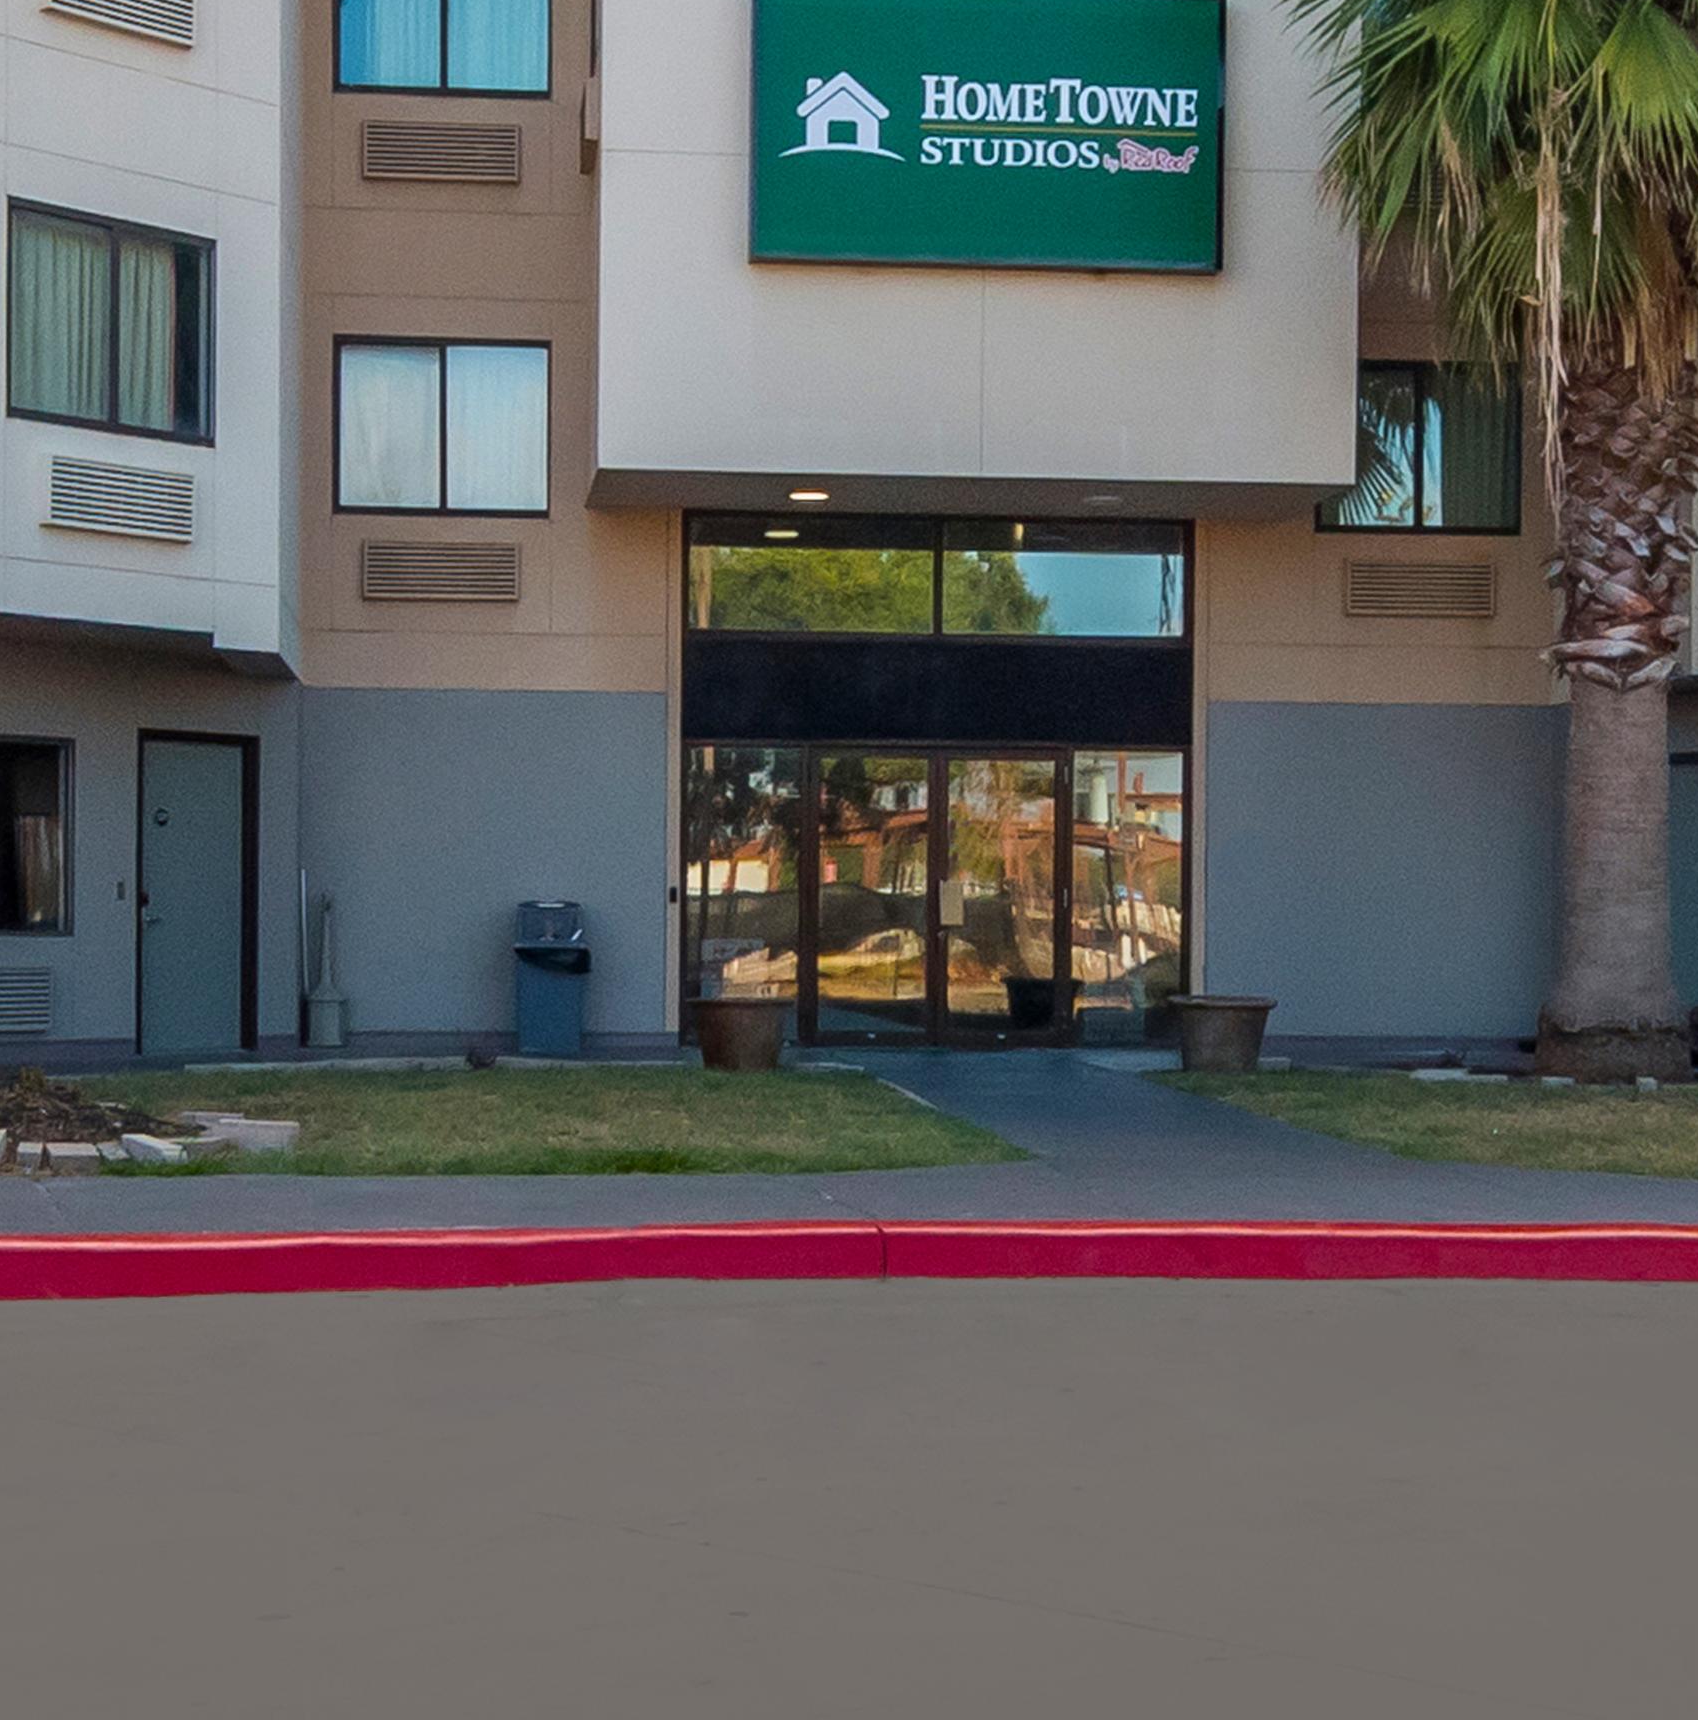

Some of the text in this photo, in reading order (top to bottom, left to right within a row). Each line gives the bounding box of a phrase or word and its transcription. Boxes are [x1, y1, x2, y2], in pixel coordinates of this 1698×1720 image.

[919, 136, 1101, 169] STUDIOS
[1120, 146, 1152, 172] Red
[1151, 146, 1199, 174] Roof
